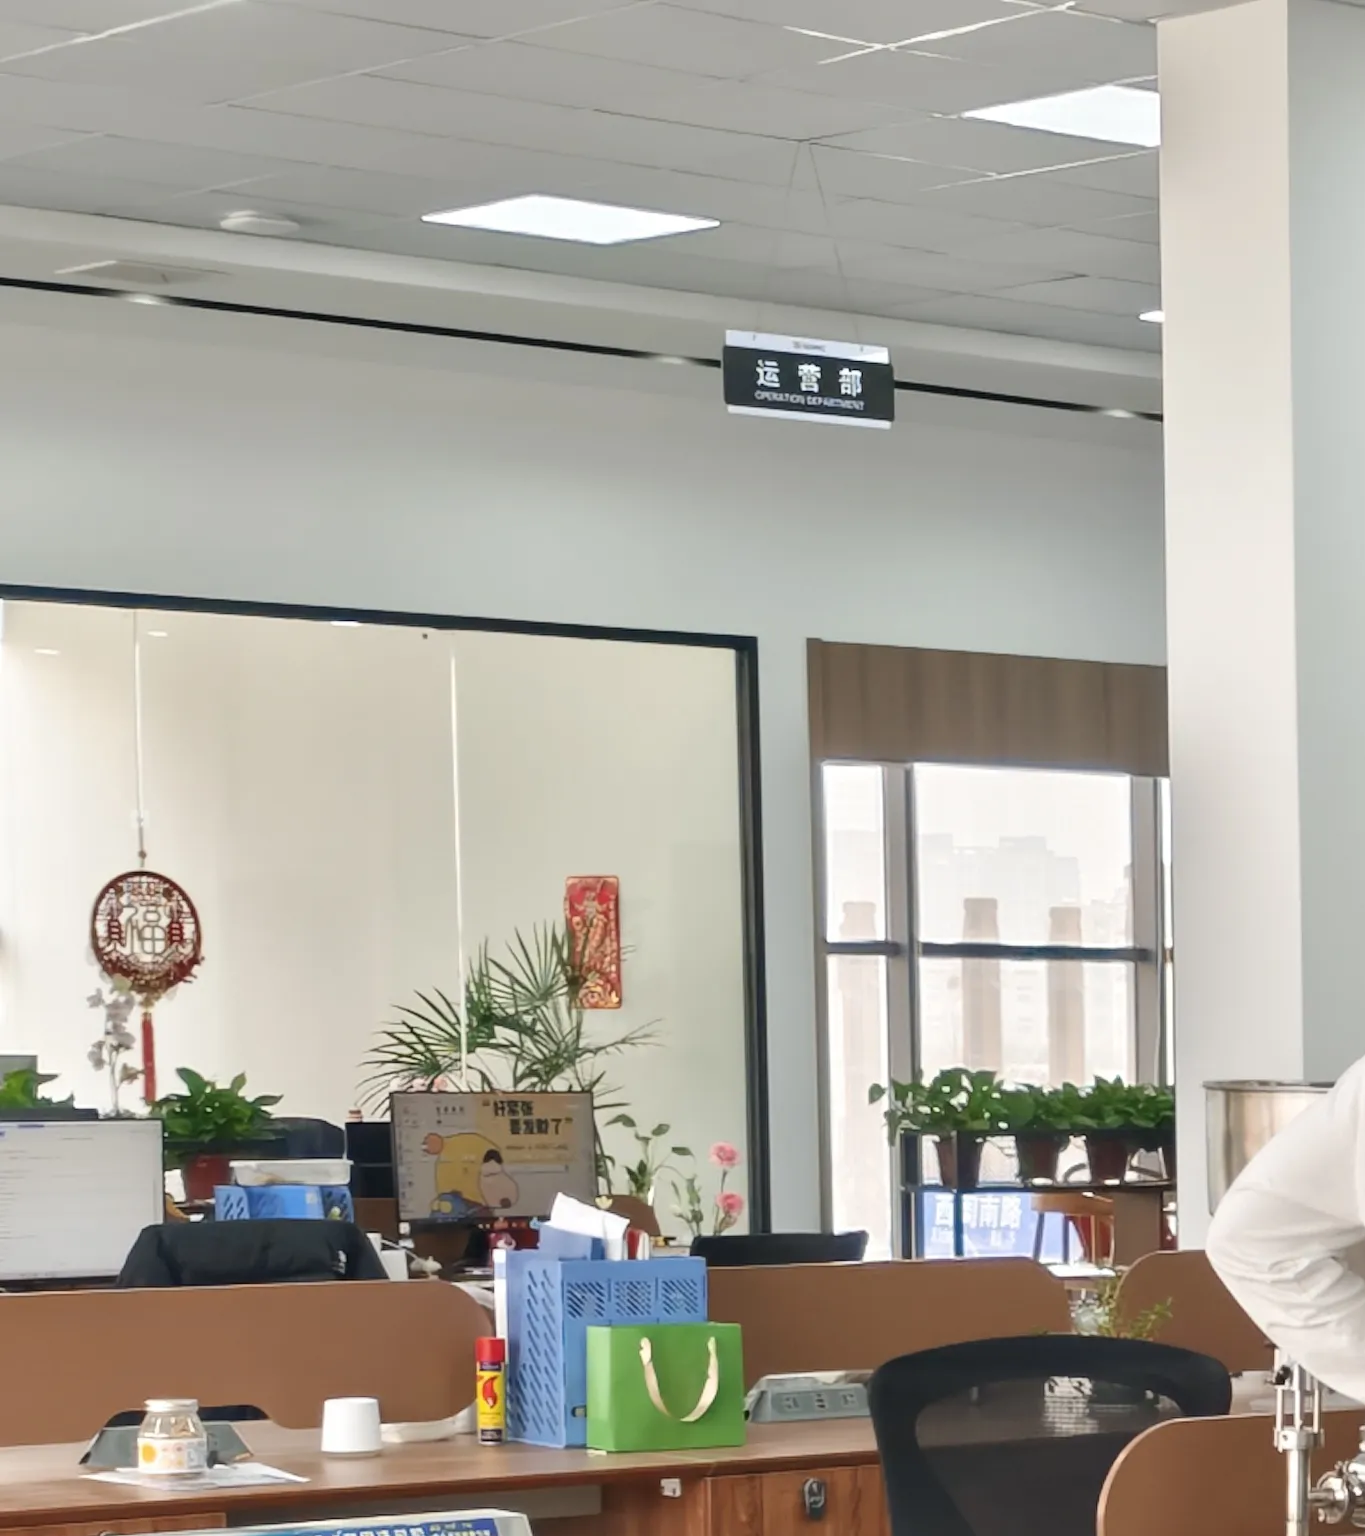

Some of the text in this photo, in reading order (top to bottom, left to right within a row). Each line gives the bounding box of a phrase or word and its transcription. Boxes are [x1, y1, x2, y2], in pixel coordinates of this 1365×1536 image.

[755, 359, 863, 397] 运营部
[754, 390, 805, 405] OPERATION
